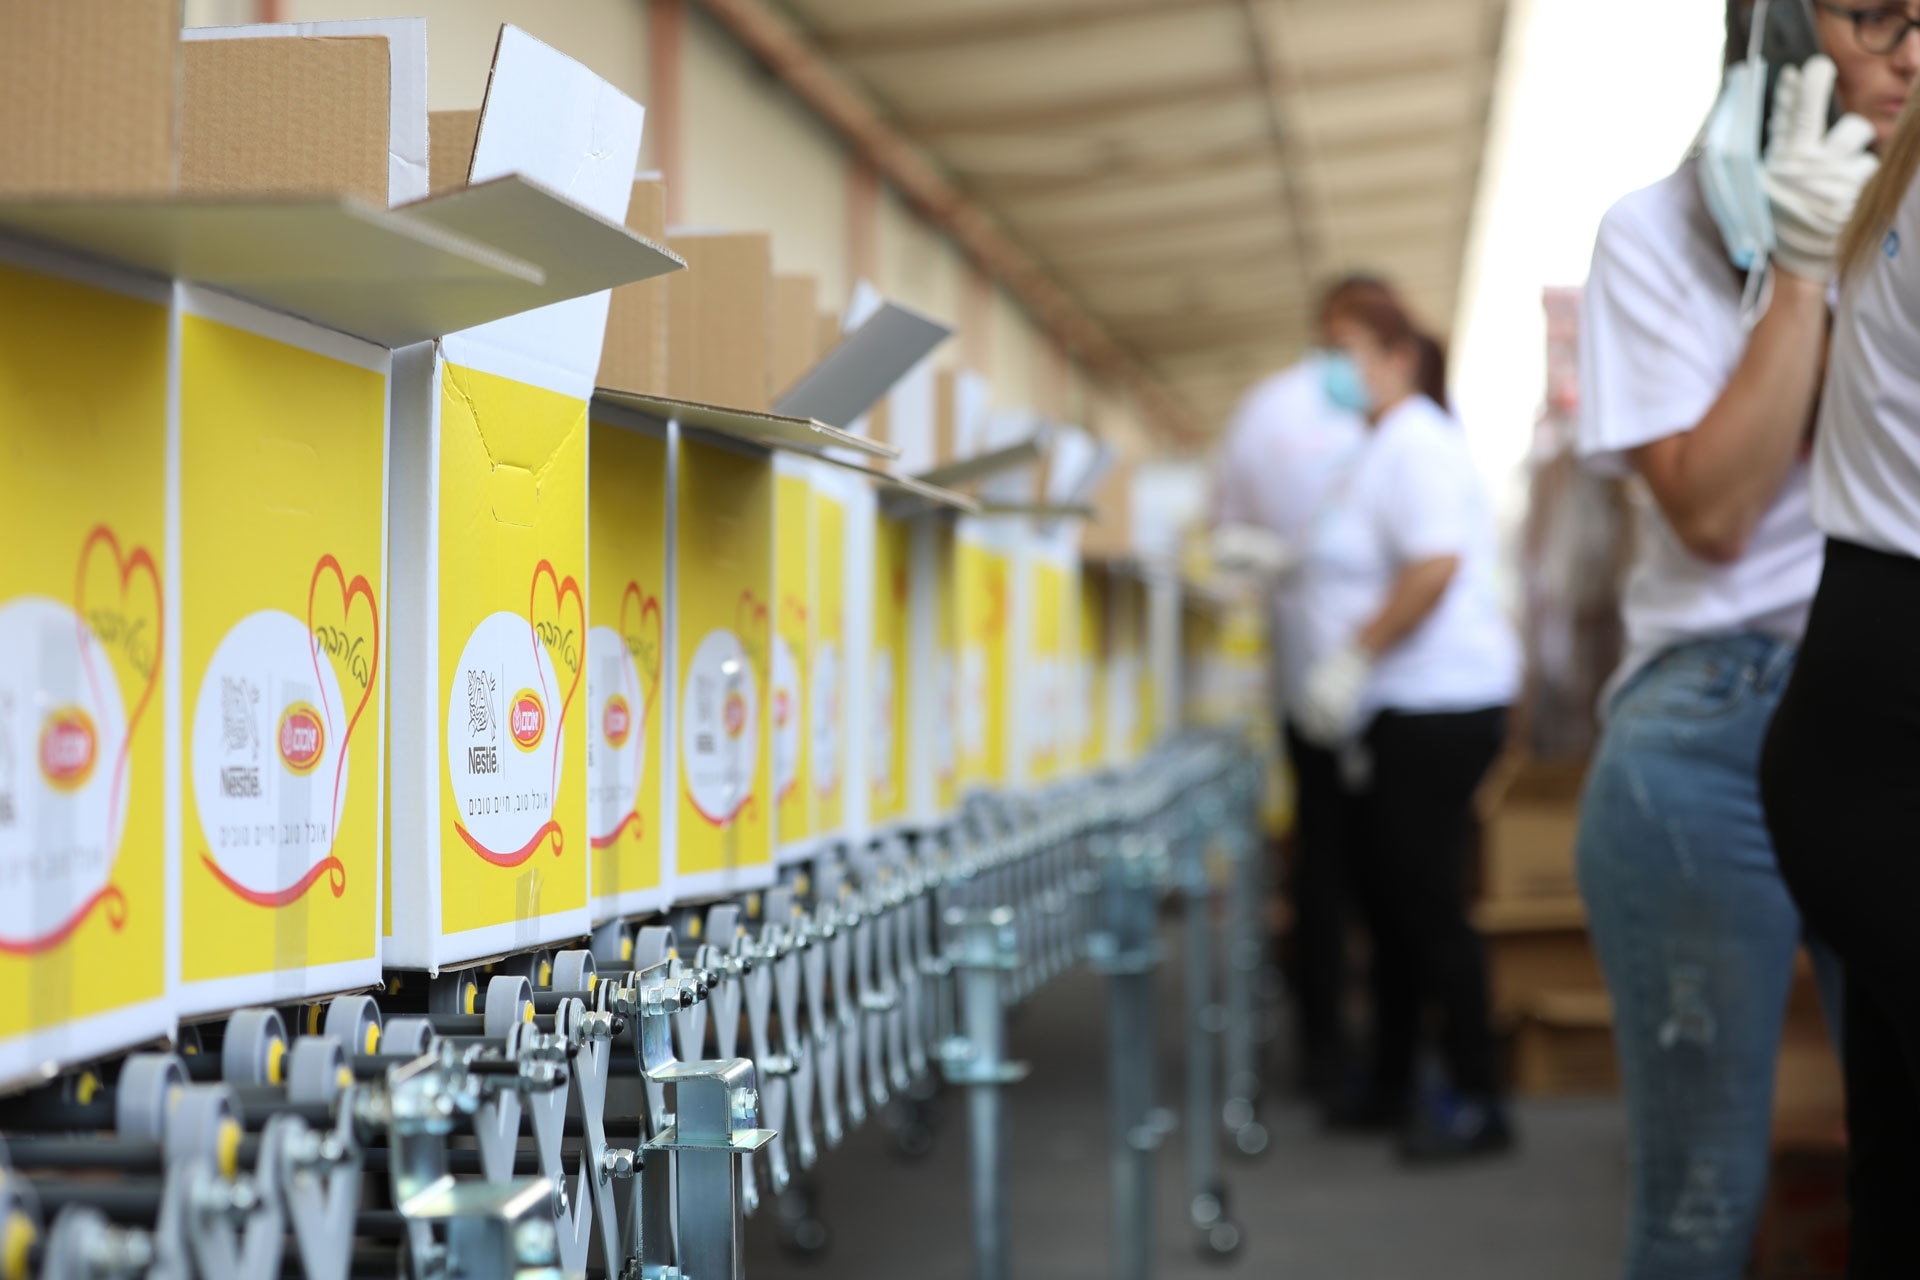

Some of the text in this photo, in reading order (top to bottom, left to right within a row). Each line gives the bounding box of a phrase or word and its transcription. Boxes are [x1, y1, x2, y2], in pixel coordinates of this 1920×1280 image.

[536, 620, 577, 674] באהבה
[468, 745, 497, 775] Nestlé
[468, 797, 491, 816] טובים
[494, 795, 510, 814] חיים
